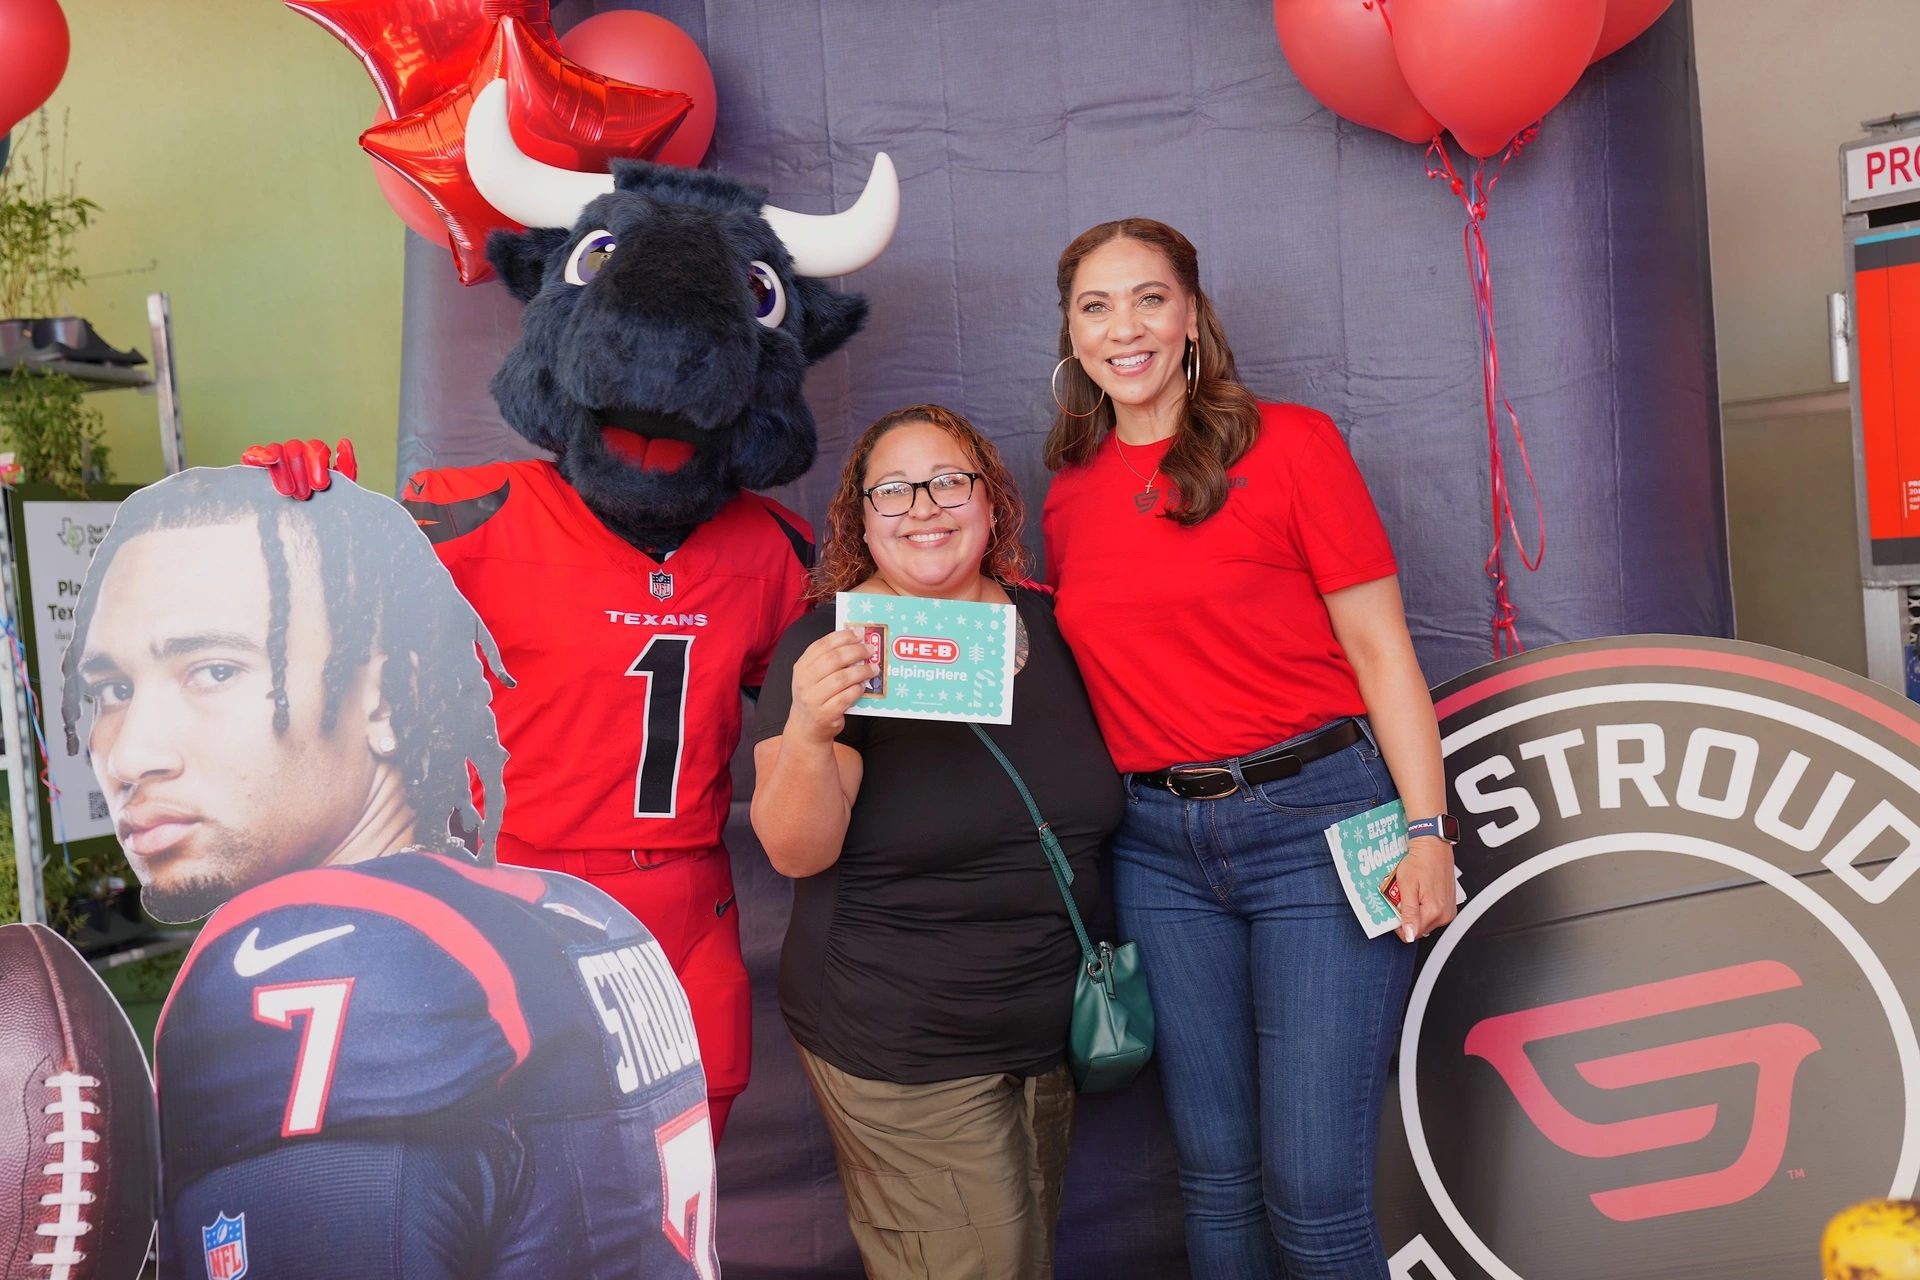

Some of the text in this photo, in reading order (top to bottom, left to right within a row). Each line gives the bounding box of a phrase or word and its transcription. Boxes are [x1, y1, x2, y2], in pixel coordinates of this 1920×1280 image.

[1866, 145, 1920, 190] PR
[58, 581, 82, 597] Pla
[47, 605, 74, 621] Tex
[604, 610, 709, 627] TEXANS
[899, 641, 953, 658] H-E-B
[624, 633, 696, 818] 1
[1366, 813, 1399, 840] HAPPY
[1454, 723, 1920, 904] STROUD
[252, 977, 355, 1138] 7
[1786, 1168, 1806, 1180] TM
[209, 1243, 243, 1279] NFL
